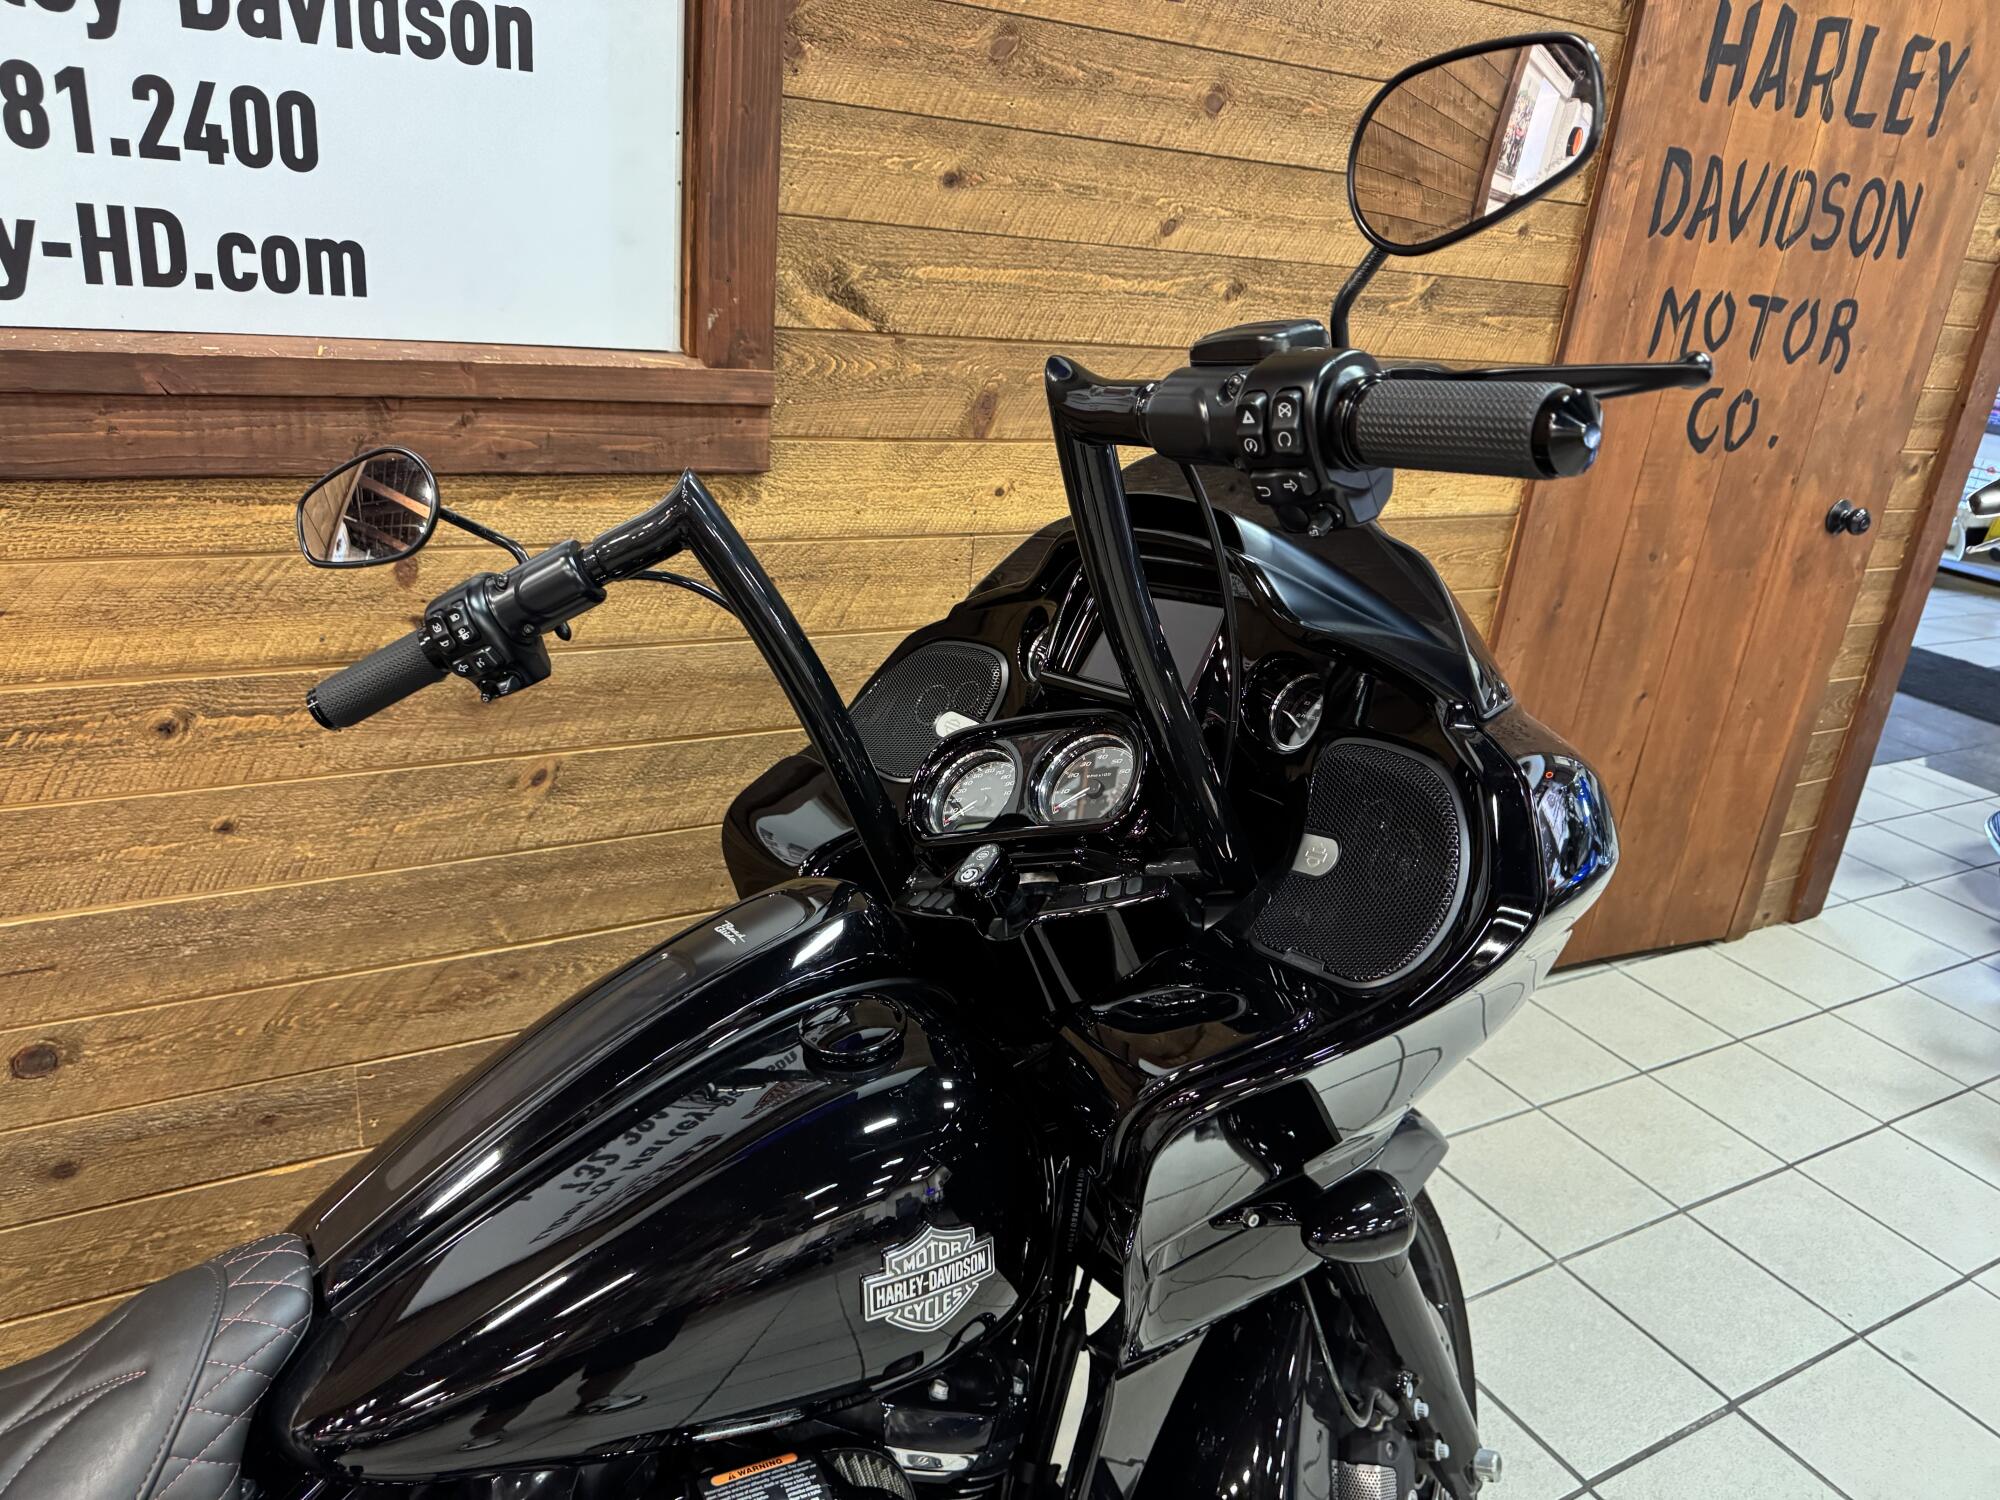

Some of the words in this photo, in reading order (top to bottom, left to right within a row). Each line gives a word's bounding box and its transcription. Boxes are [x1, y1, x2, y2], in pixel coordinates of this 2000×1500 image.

[1700, 0, 1970, 138] HARLEY
[0, 59, 319, 173] 81.2400
[1648, 146, 1924, 261] DAVIDSON
[1647, 286, 1859, 374] MOTOR
[1686, 387, 1779, 454] CO.
[875, 1250, 987, 1309] HARLEY-DAVIDSON
[903, 1239, 963, 1273] MOTOR
[903, 1286, 964, 1322] CYCLES
[736, 1458, 784, 1477] WARNING
